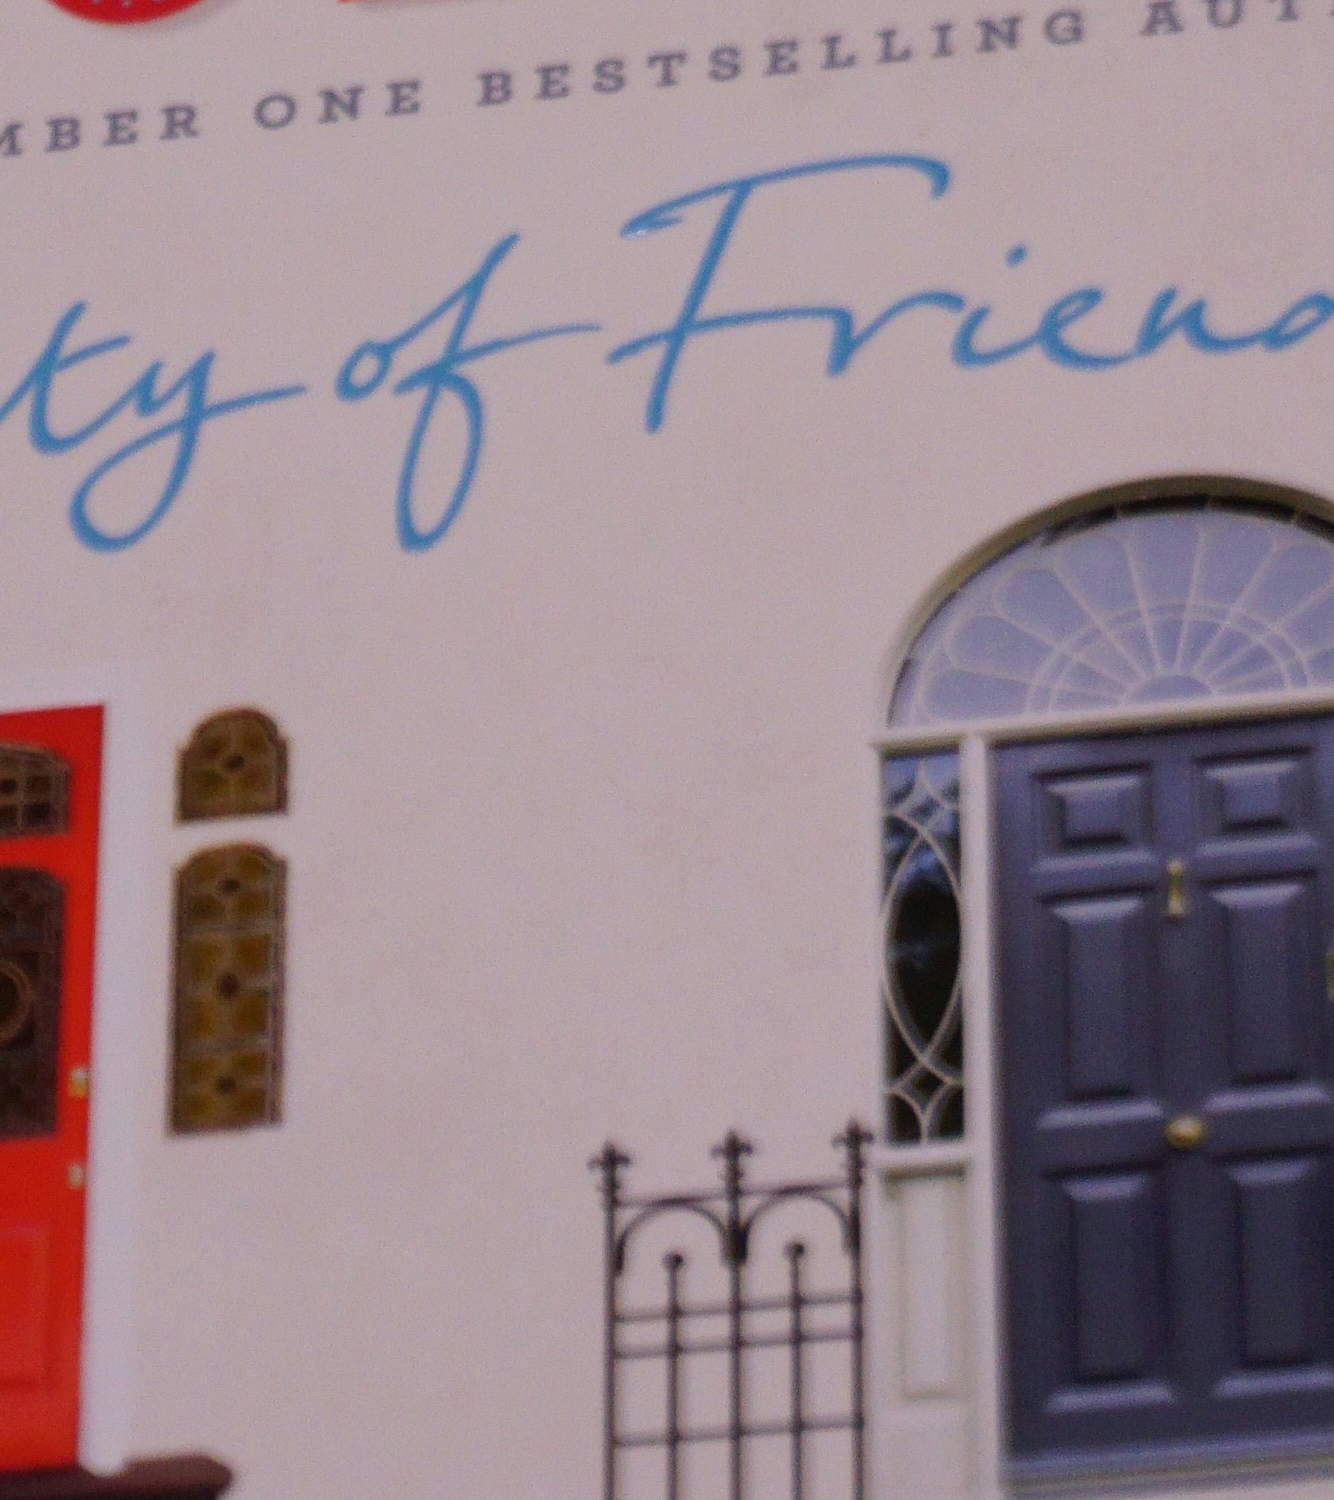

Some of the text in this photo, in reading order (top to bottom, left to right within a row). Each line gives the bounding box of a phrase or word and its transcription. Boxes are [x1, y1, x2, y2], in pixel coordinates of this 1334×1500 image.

[252, 76, 425, 132] ONE
[477, 5, 1090, 109] BESTSELLING
[332, 232, 605, 552] of
